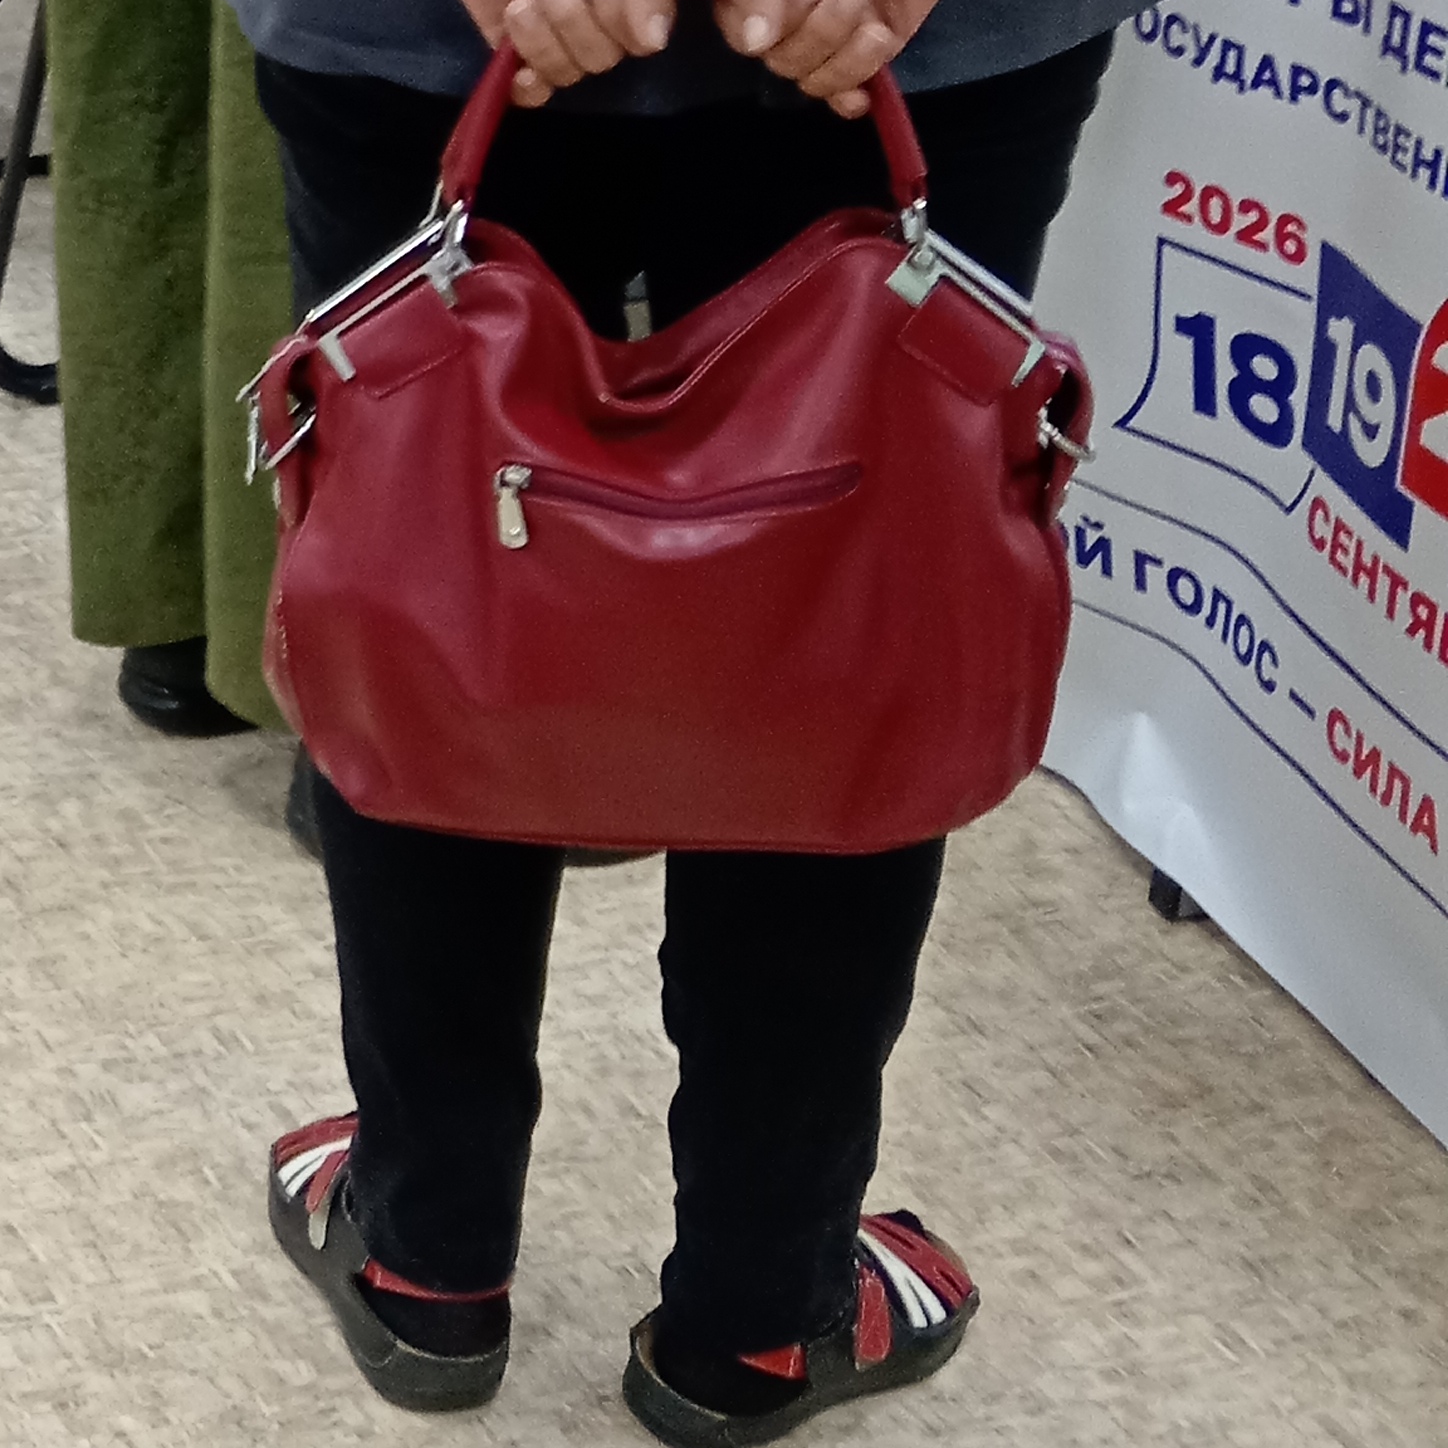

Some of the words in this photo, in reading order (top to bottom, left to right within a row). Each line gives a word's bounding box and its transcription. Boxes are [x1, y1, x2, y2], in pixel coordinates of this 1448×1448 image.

[1380, 0, 1448, 88] ДЕ
[1161, 168, 1309, 266] 2026
[1174, 310, 1298, 450] 18
[1326, 315, 1397, 470] 19
[1133, 548, 1280, 695] ГОЛОС
[1326, 706, 1439, 856] СИЛА
